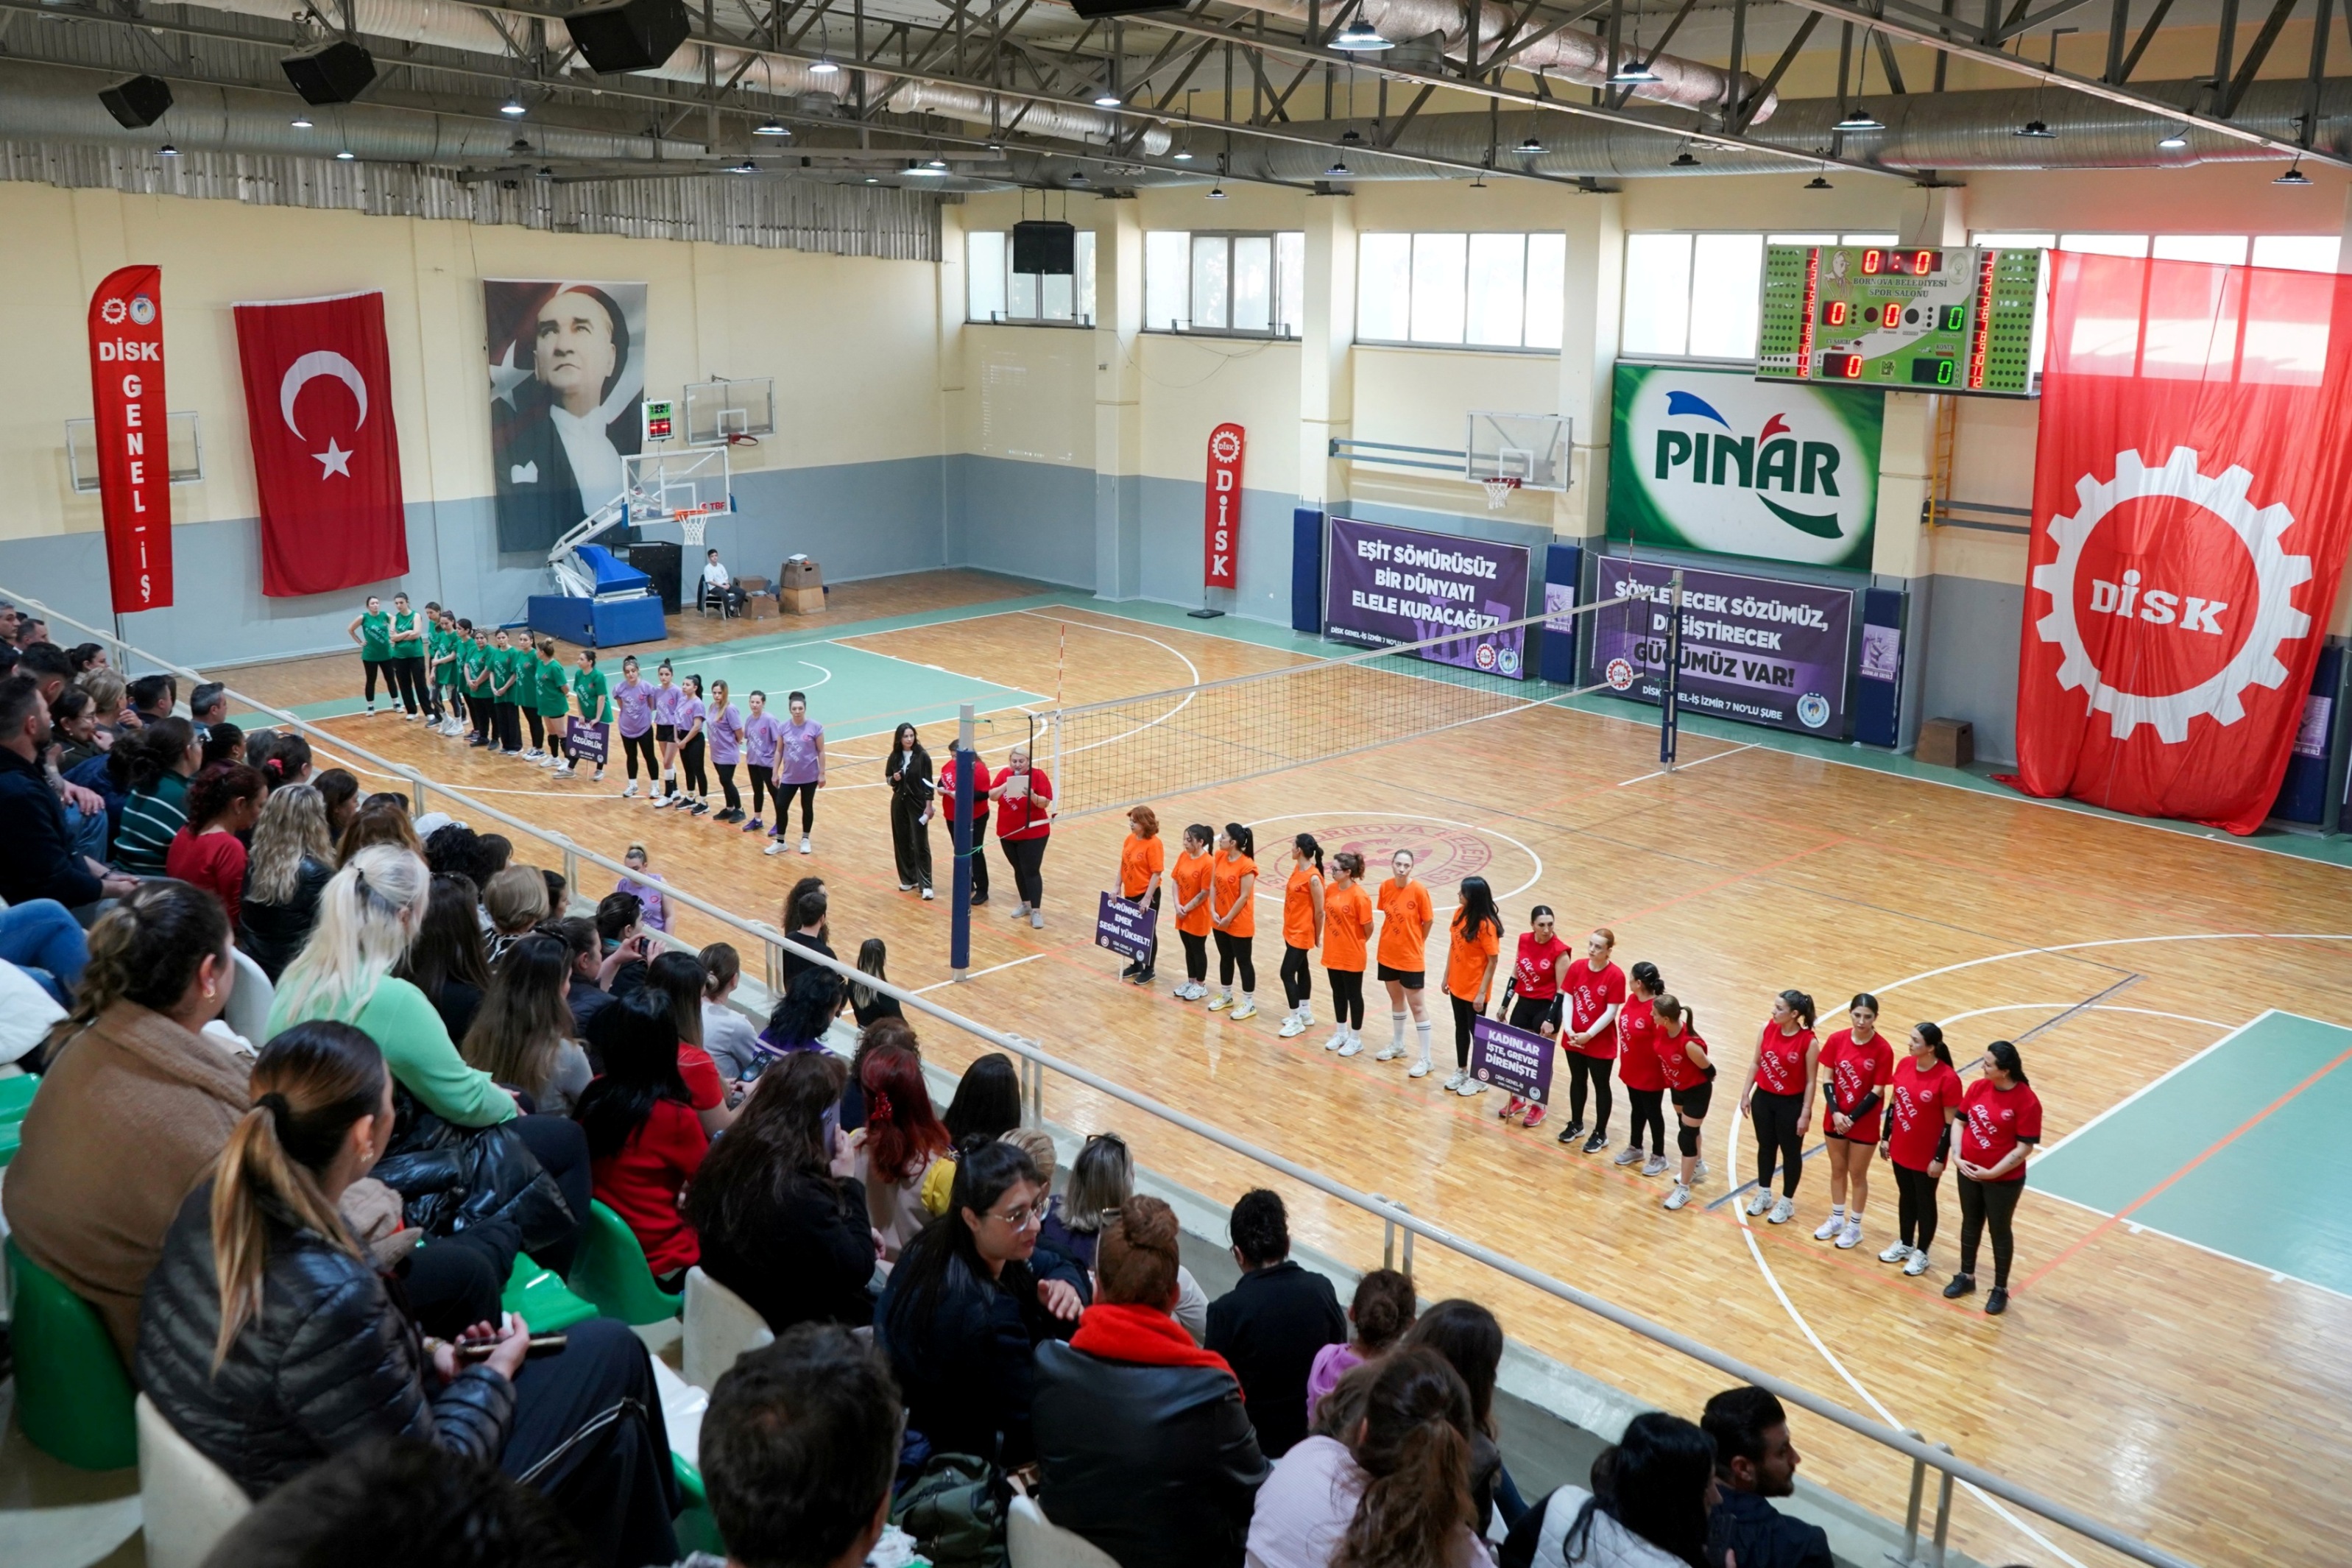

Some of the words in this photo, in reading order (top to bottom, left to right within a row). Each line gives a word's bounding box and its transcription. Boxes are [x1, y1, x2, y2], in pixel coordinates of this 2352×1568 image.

[1854, 278, 1893, 286] BORNOVA
[1894, 289, 1929, 297] SALONU
[1831, 302, 1846, 325] 0
[1885, 304, 1900, 327] 0
[1948, 306, 1963, 330] 0
[99, 337, 160, 361] DİSK
[1847, 355, 1862, 378] 0
[1938, 361, 1952, 384] 0
[1218, 442, 1235, 451] DİSK
[1656, 429, 1840, 497] PINAR
[710, 501, 725, 510] TBF
[1212, 469, 1233, 576] DİSK
[1357, 540, 1391, 562] EŞİT
[1394, 545, 1497, 579] SÖMÜRÜSÜZ
[1375, 567, 1401, 589] BİR
[1404, 573, 1475, 602] DÜNYAYI
[1352, 590, 1397, 614] ELELE
[1400, 600, 1500, 634] KURACAĞIZ!
[1614, 579, 1727, 614] SÖYLEECEK
[1730, 596, 1829, 632] SÖZÜMÜZ,
[2090, 569, 2228, 635] DİSK
[1331, 626, 1343, 635] DİSK
[1344, 629, 1367, 640] GENEL-İŞ
[1368, 632, 1382, 643] İZMİR
[1653, 613, 1781, 651] DĞİŞTİRECEK
[1634, 640, 1737, 682] GÜÜMÜZ
[1742, 662, 1795, 688] VAR!
[1642, 685, 1661, 698] DİSK
[1701, 695, 1724, 710] İZMİR
[1726, 702, 1731, 710] 7
[1732, 703, 1759, 716] NO'LU
[1760, 708, 1783, 720] ŞUBE
[573, 734, 603, 750] ÖZGÜRLÜK
[1099, 920, 1120, 935] SESİNİ
[1120, 928, 1151, 947] YÜKSELT!
[1115, 914, 1133, 927] EMEK
[1486, 1041, 1506, 1057] İŞTE,
[1507, 1050, 1539, 1067] GREVDE
[1488, 1030, 1540, 1056] KADINLAR
[1486, 1053, 1538, 1080] DİRENİŞTE
